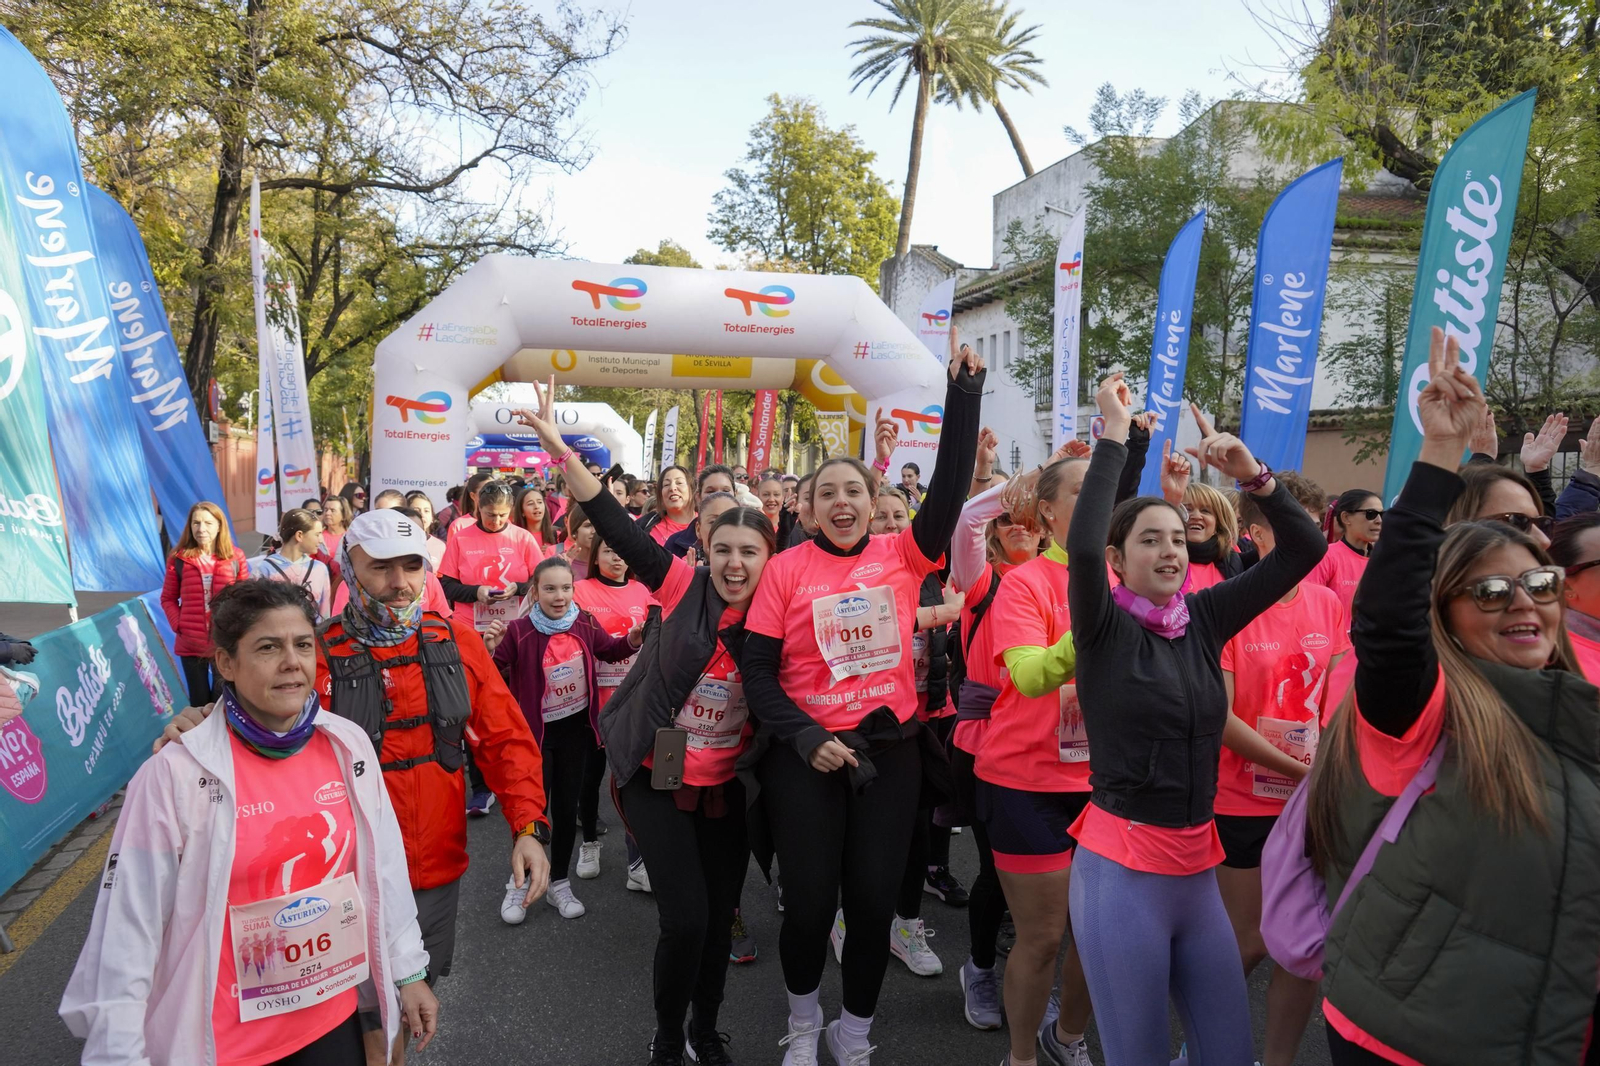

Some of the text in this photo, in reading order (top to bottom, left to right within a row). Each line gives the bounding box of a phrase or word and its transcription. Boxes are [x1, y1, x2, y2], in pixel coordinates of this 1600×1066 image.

[1408, 174, 1503, 436] atiste
[571, 316, 647, 330] TotalEnergies
[723, 323, 795, 336] TotalEnergies
[435, 332, 497, 346] LasCarreras
[1252, 271, 1314, 415] Marlene
[588, 356, 660, 367] Instituto Municipal
[693, 359, 703, 367] DE
[600, 366, 648, 375] de Deportes
[1148, 309, 1185, 432] Marlene
[756, 391, 772, 447] Santander
[384, 429, 450, 442] TotalEnergies
[381, 477, 447, 488] totalenergies.es
[836, 604, 869, 614] ASTURIANA
[840, 625, 873, 642] 016
[850, 645, 866, 653] 5738
[1245, 642, 1280, 652] OYSHO
[868, 659, 894, 668] Santander
[56, 644, 111, 747] Batiste
[556, 683, 576, 696] 016
[806, 682, 896, 705] CARRERA DE LA MUJER
[846, 701, 862, 711] 2025
[104, 707, 114, 727] EN
[693, 705, 725, 722] 016
[698, 723, 714, 731] 2120
[10, 761, 41, 788] ESPAÑA
[1263, 785, 1293, 796] OYSHO
[236, 801, 275, 819] YSHO
[279, 904, 327, 925] ASTURIANA
[243, 921, 271, 932] SUMA
[284, 932, 332, 963] 016
[300, 962, 322, 977] 2574
[260, 960, 353, 995] CARRERA DE LA MUJER SEVILLA
[325, 973, 358, 992] Santander
[256, 994, 301, 1011] OYSHO
